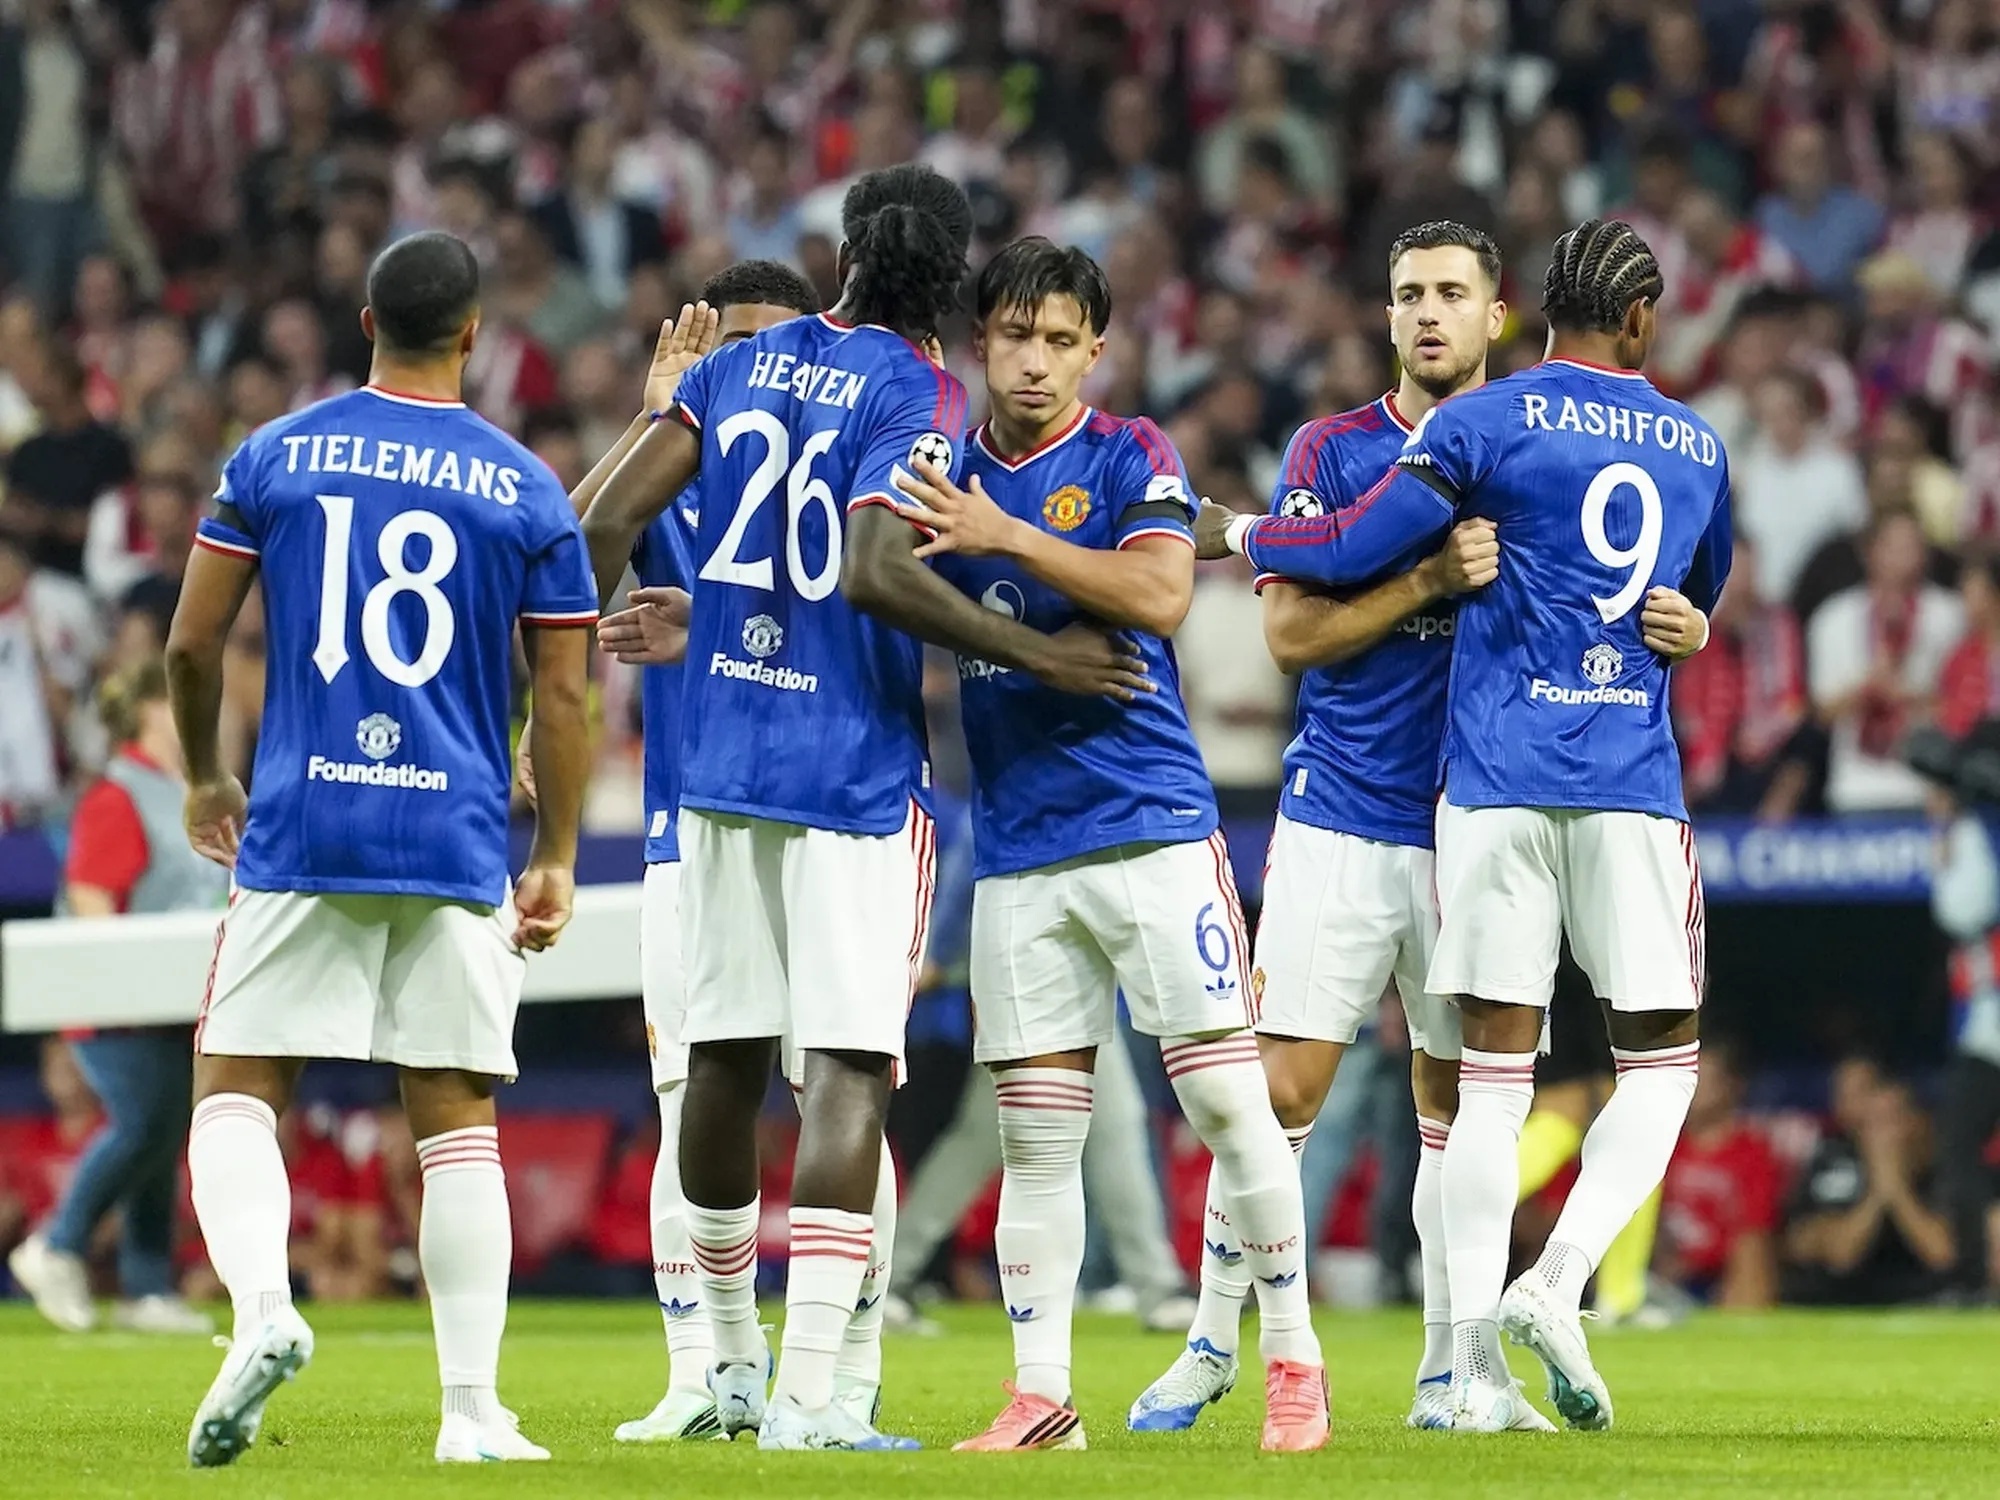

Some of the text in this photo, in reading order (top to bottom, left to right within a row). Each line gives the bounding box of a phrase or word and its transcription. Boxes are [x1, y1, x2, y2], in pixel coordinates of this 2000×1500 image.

[747, 351, 867, 410] HEAVEN
[1522, 394, 1717, 467] RASHFORD
[282, 435, 521, 506] TIELEMANS
[698, 408, 842, 602] 26
[1581, 462, 1664, 625] 9
[312, 494, 458, 688] 18
[1399, 612, 1457, 641] apd
[958, 654, 1013, 682] Snap
[1529, 677, 1648, 707] Foundaon
[308, 755, 448, 791] Foundation
[1195, 902, 1230, 972] 6
[1002, 1263, 1031, 1277] FC
[1240, 1235, 1297, 1254] MUFC
